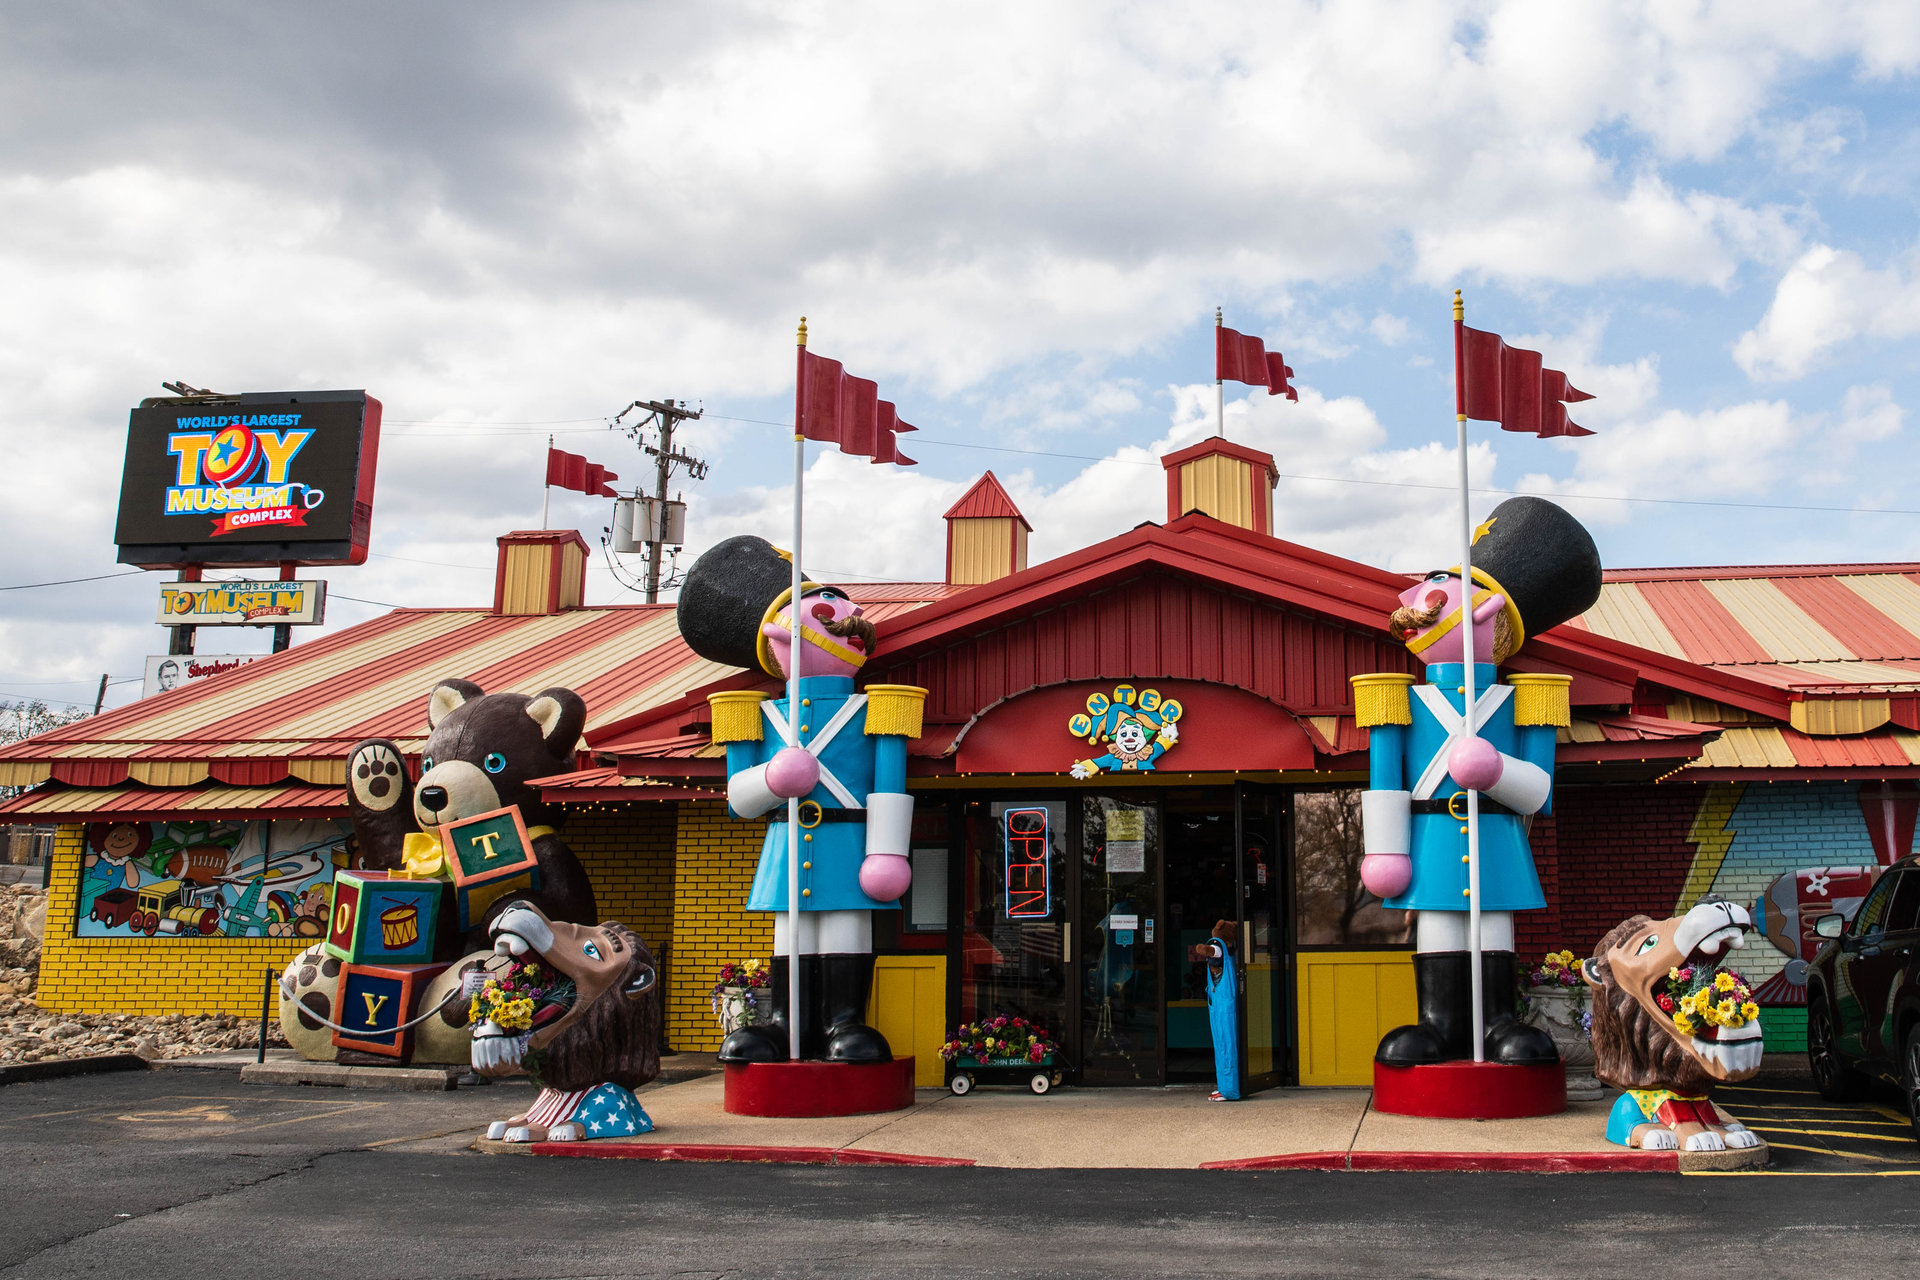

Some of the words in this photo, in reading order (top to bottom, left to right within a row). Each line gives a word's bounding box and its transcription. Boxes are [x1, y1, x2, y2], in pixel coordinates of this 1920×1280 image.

[177, 415, 240, 429] WORLD'S
[241, 414, 302, 426] LARGEST
[168, 425, 315, 488] TOY
[165, 487, 292, 515] MUSEUM
[231, 509, 293, 525] COMPLEX
[220, 582, 259, 591] WORLD'S
[262, 582, 304, 590] LARGEST
[250, 607, 283, 617] COMPLEX
[1071, 687, 1179, 735] ENTER
[471, 831, 500, 860] T
[1009, 811, 1045, 915] OPEN
[336, 903, 350, 936] O
[361, 992, 389, 1026] Y
